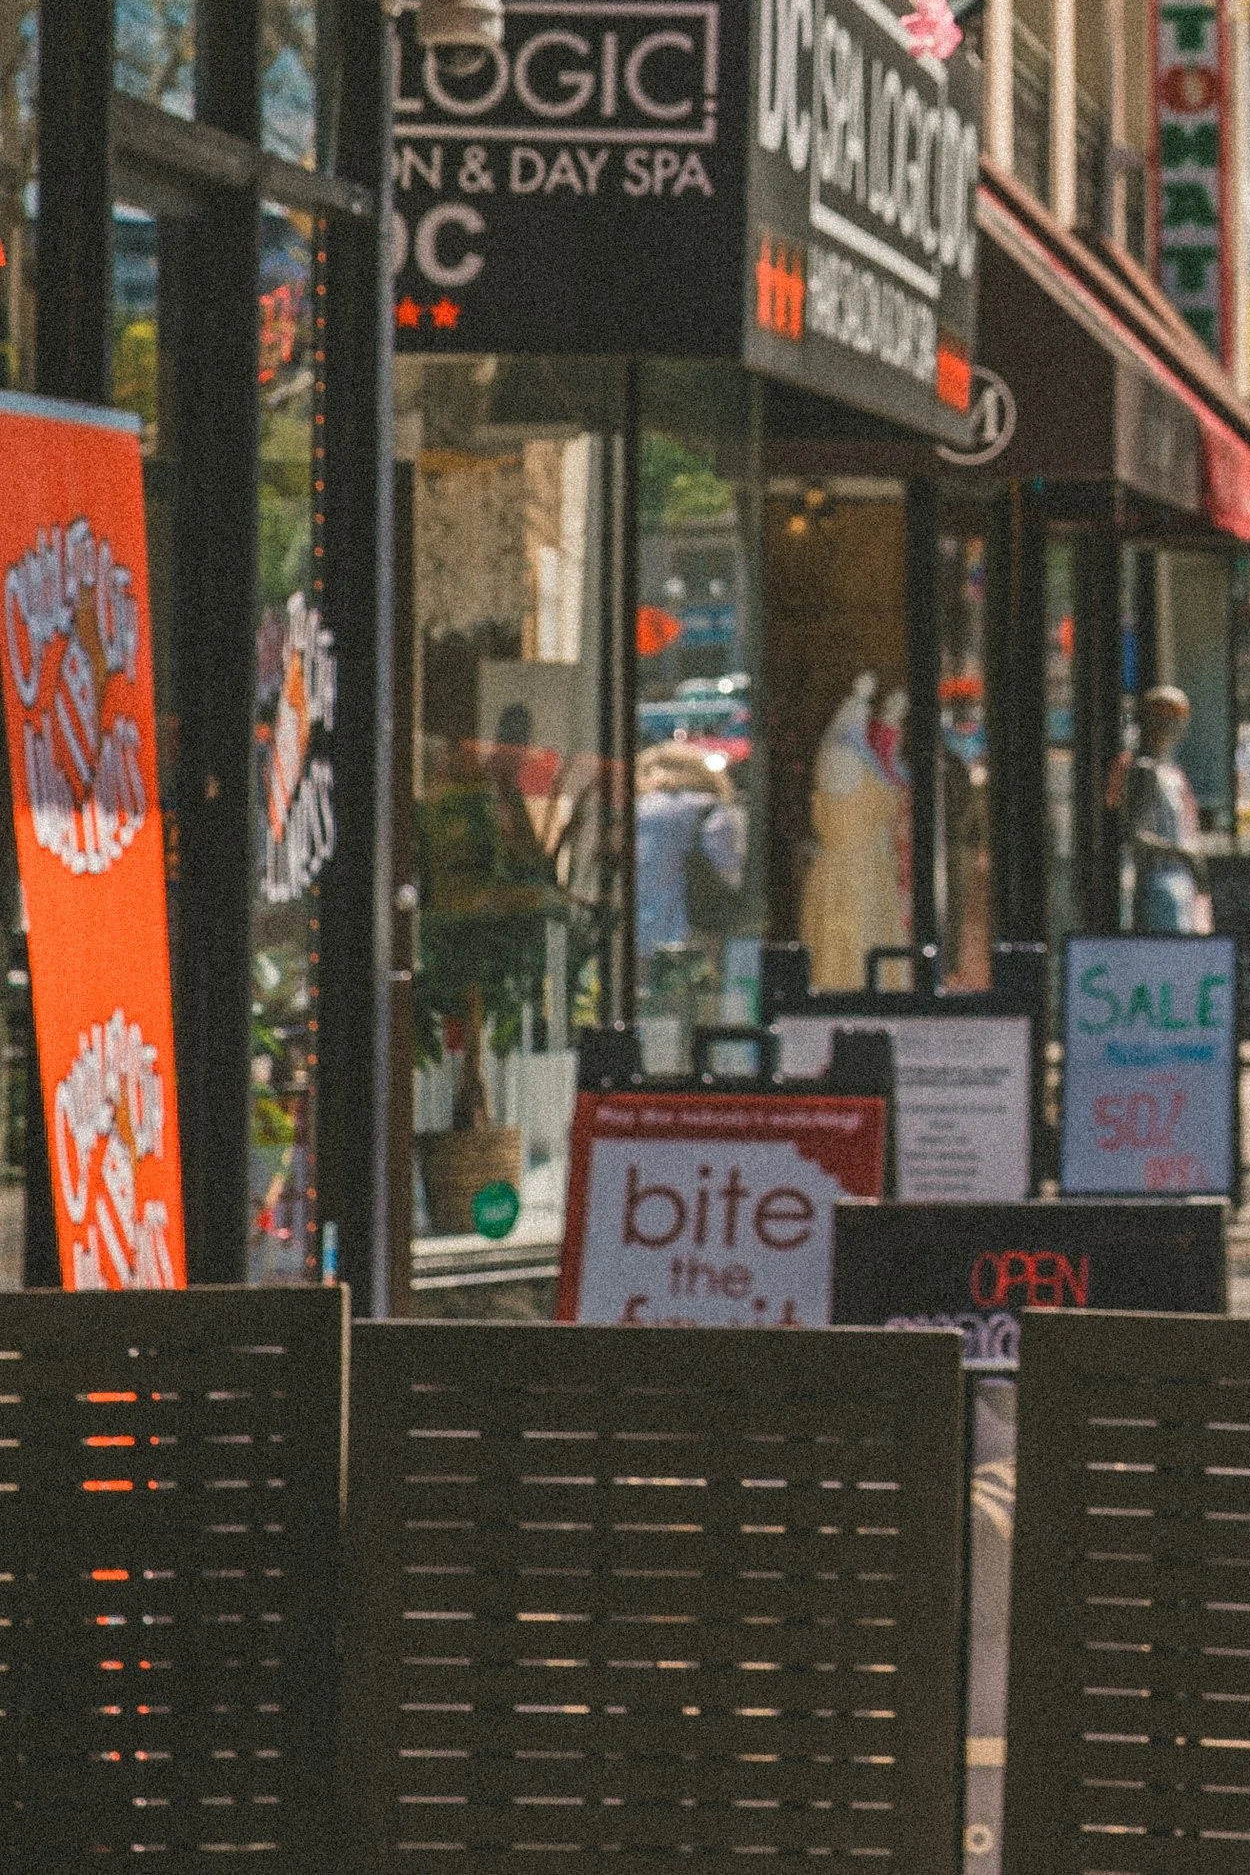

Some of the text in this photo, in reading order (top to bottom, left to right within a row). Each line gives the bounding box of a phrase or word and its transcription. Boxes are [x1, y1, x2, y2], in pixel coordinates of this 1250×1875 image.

[458, 145, 495, 193] &
[510, 147, 610, 195] DAY
[622, 148, 715, 197] SPA
[1076, 962, 1228, 1036] SALE
[622, 1163, 815, 1250] bite
[669, 1257, 752, 1299] the
[969, 1250, 1092, 1309] OPEN
